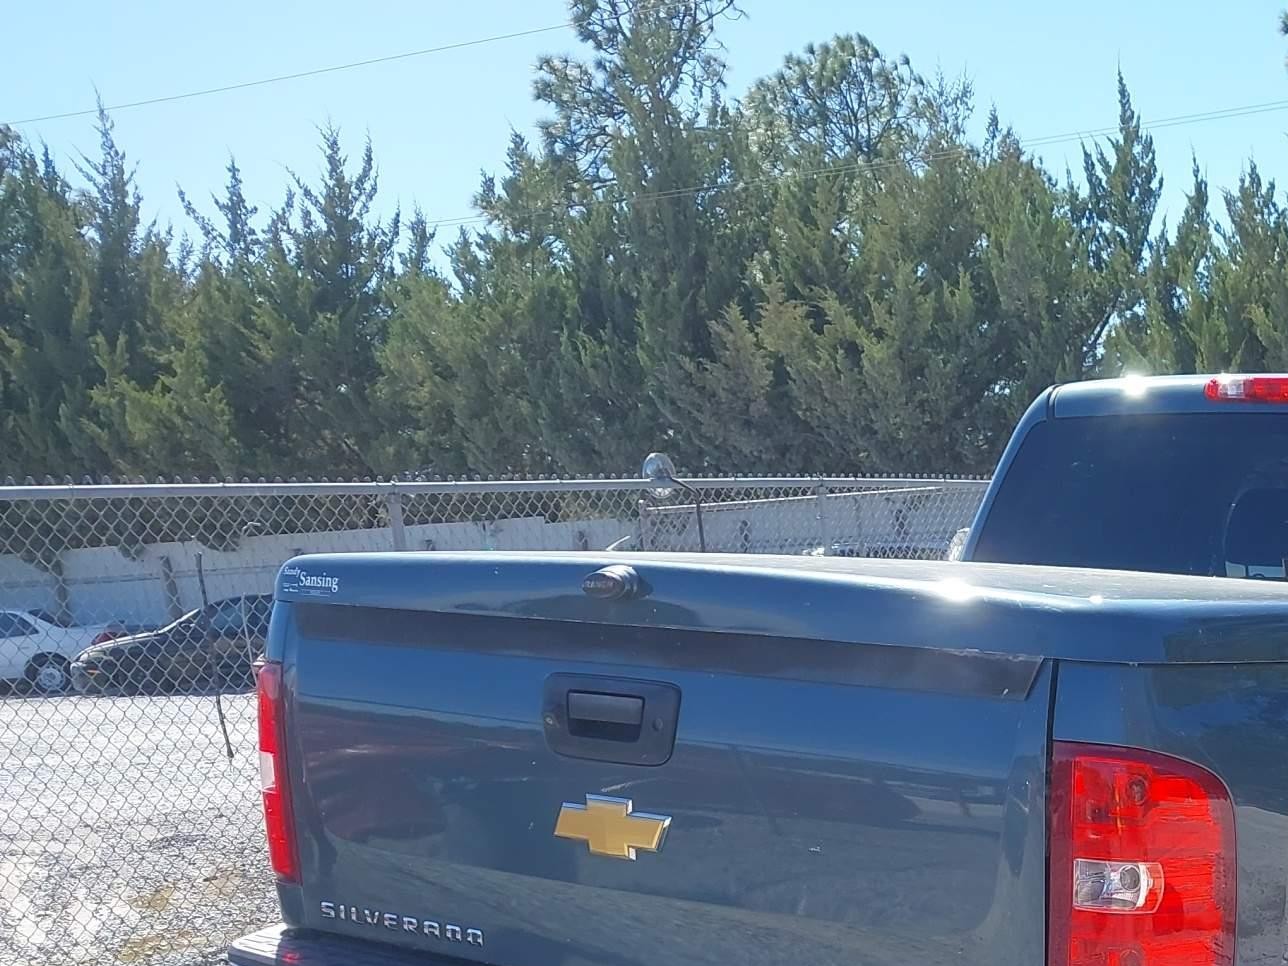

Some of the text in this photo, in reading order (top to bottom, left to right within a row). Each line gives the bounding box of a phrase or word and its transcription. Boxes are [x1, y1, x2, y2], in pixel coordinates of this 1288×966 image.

[283, 566, 300, 577] Sandy
[299, 571, 339, 593] Sansing
[319, 900, 485, 947] SILVERADO
